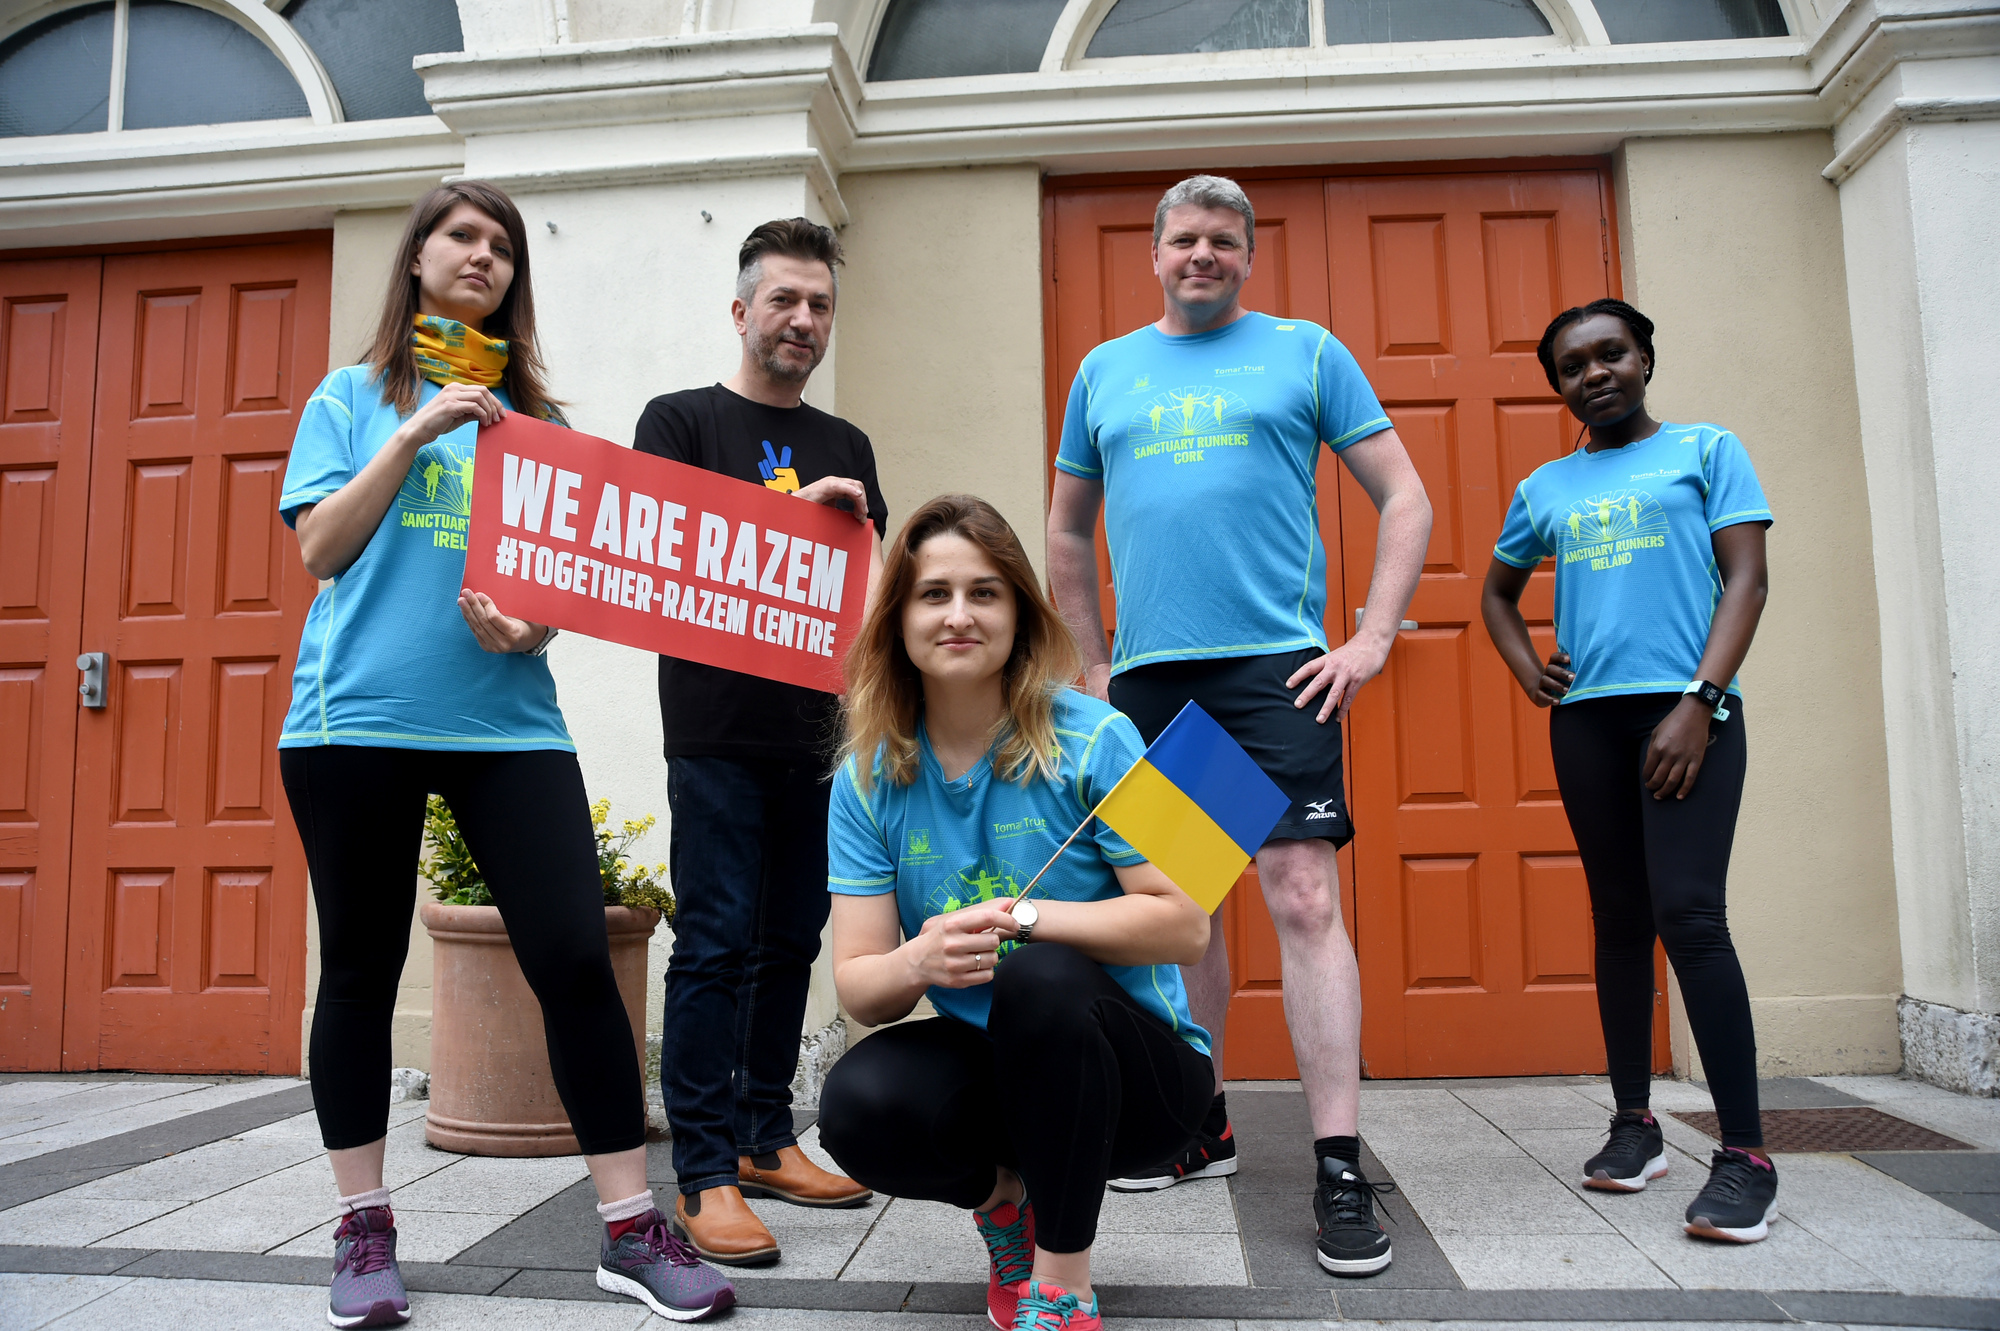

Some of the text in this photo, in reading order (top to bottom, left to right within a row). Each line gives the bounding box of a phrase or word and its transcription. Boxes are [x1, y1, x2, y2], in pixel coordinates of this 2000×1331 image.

[1214, 367, 1241, 375] Tomar
[1134, 433, 1249, 460] SANCTUARY RUNNERS
[1174, 450, 1205, 464] CORK
[502, 452, 848, 613] WE ARE RAZEM
[1564, 535, 1665, 565] ANCTUARY RUNNERS
[1591, 552, 1632, 571] IRELAND
[495, 535, 836, 657] #TOGETHER-RAZEM CENTRE
